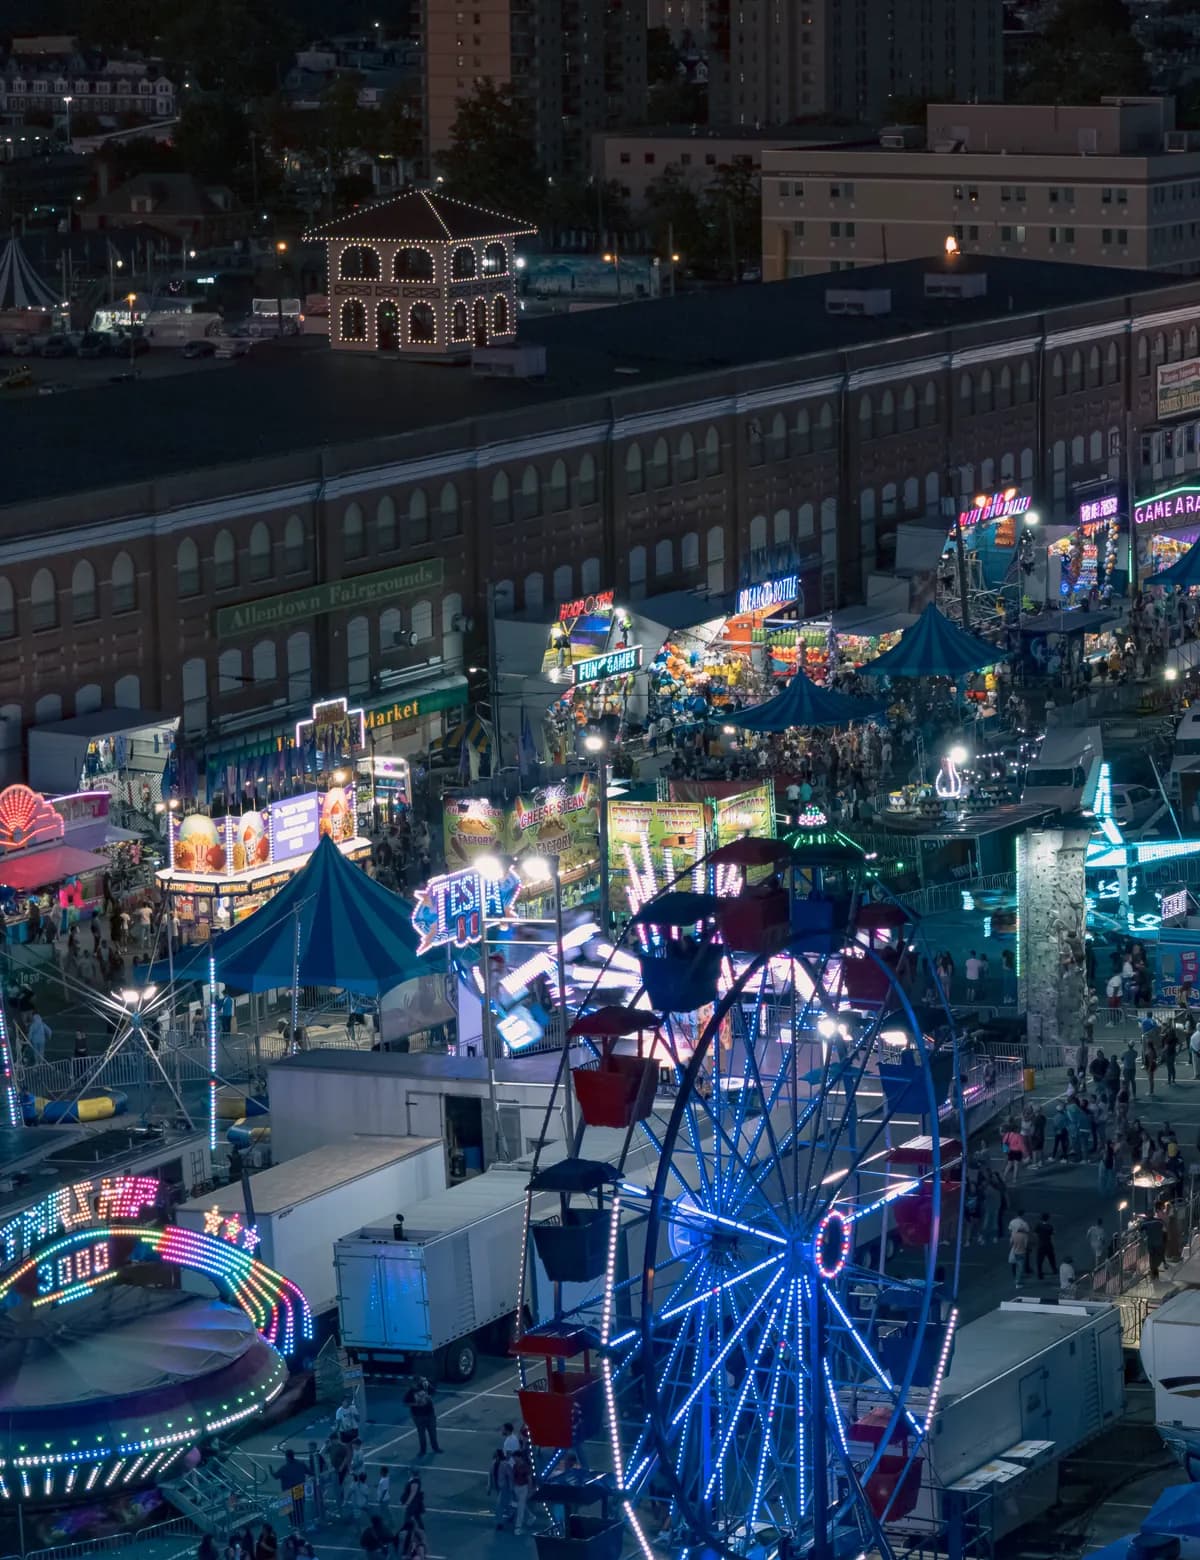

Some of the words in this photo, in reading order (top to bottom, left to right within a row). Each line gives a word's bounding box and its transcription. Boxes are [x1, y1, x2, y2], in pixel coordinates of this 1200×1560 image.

[1134, 499, 1172, 524] GAME
[229, 597, 321, 630] Allentown
[329, 566, 433, 606] Fairgrounds
[560, 600, 584, 620] HOOP
[739, 586, 762, 613] BREAK
[773, 576, 797, 603] BOTTLE
[579, 661, 598, 681] FUN
[606, 650, 636, 673] GAMES
[363, 699, 420, 731] Market
[556, 791, 585, 815] STEAK
[457, 834, 495, 845] FACTORY
[39, 1242, 109, 1293] 3000
